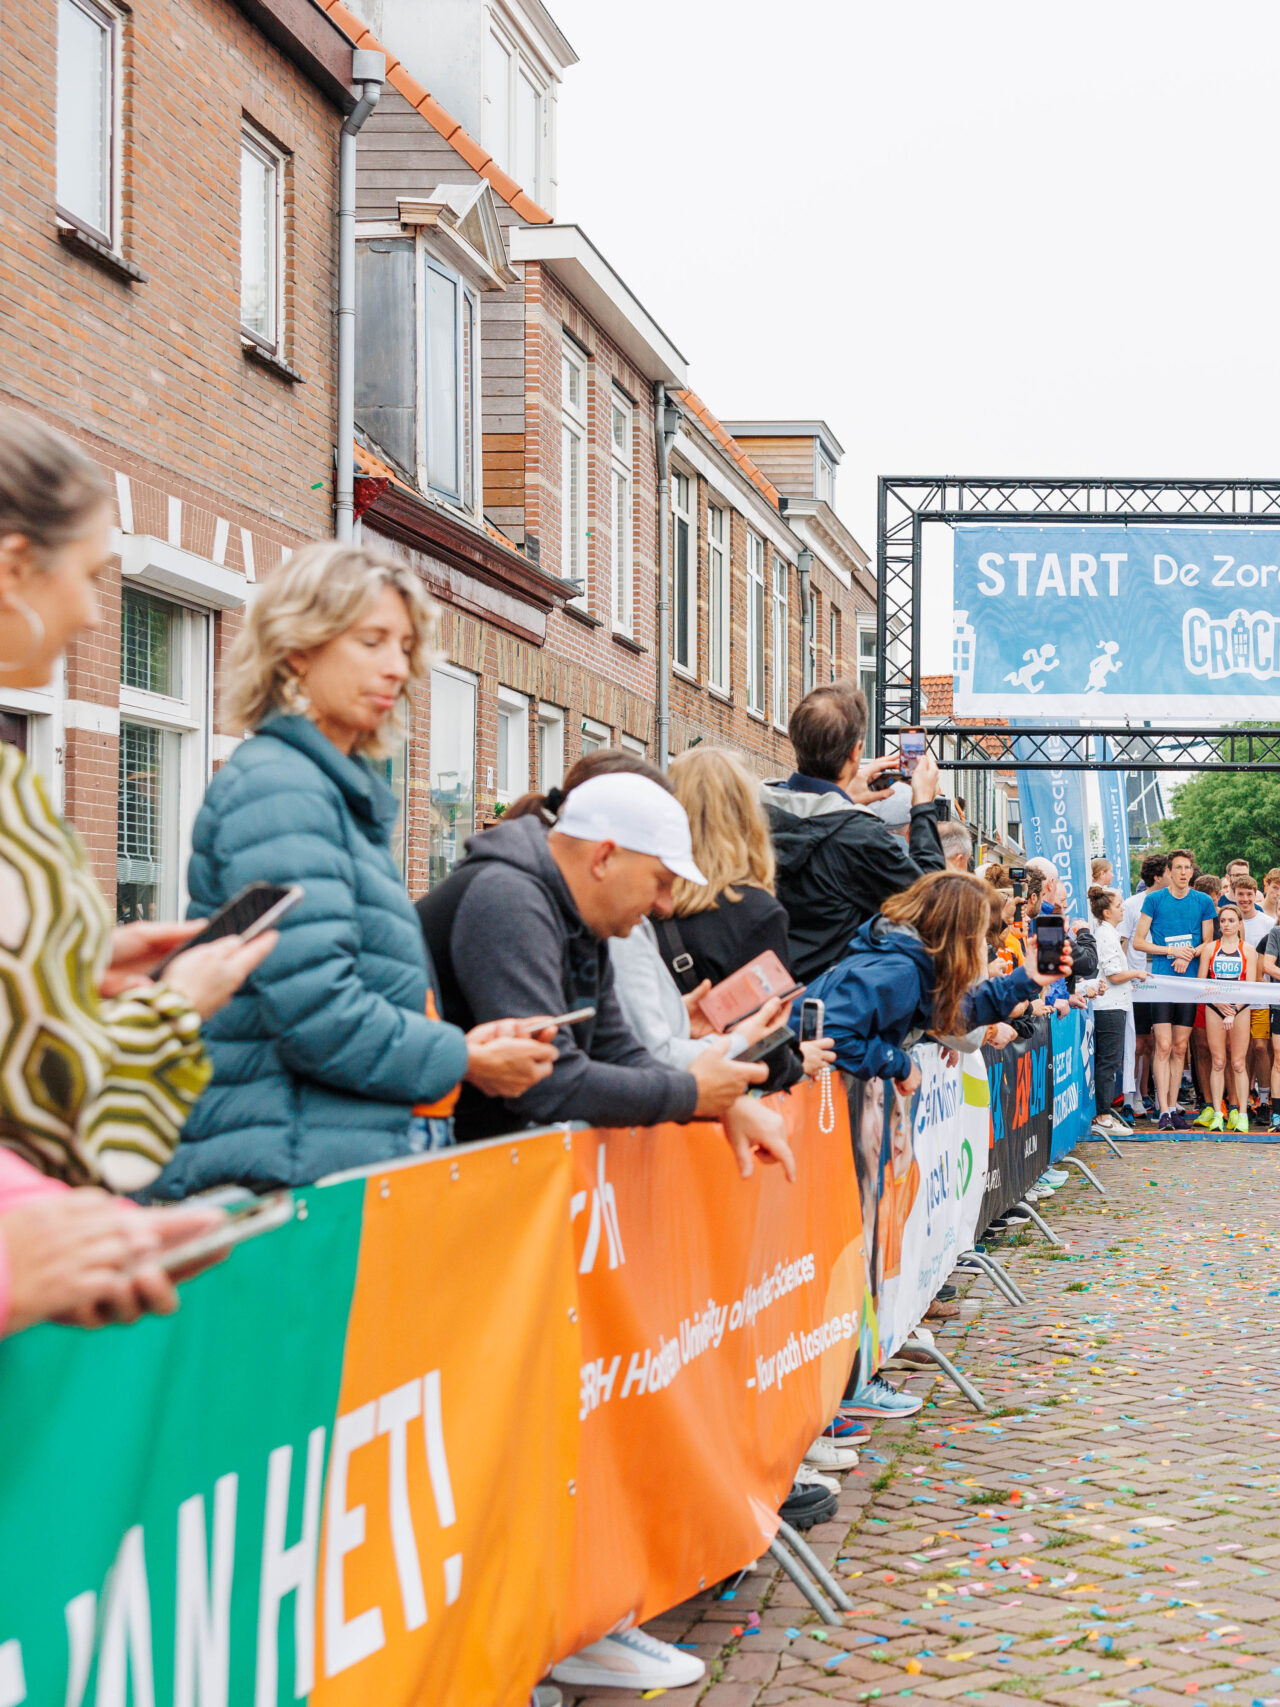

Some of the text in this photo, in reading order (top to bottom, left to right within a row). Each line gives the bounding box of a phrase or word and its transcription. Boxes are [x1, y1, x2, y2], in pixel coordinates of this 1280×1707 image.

[977, 552, 1128, 597] START
[1154, 555, 1199, 587] De
[1216, 961, 1240, 973] 5006
[254, 1368, 463, 1707] HET!
